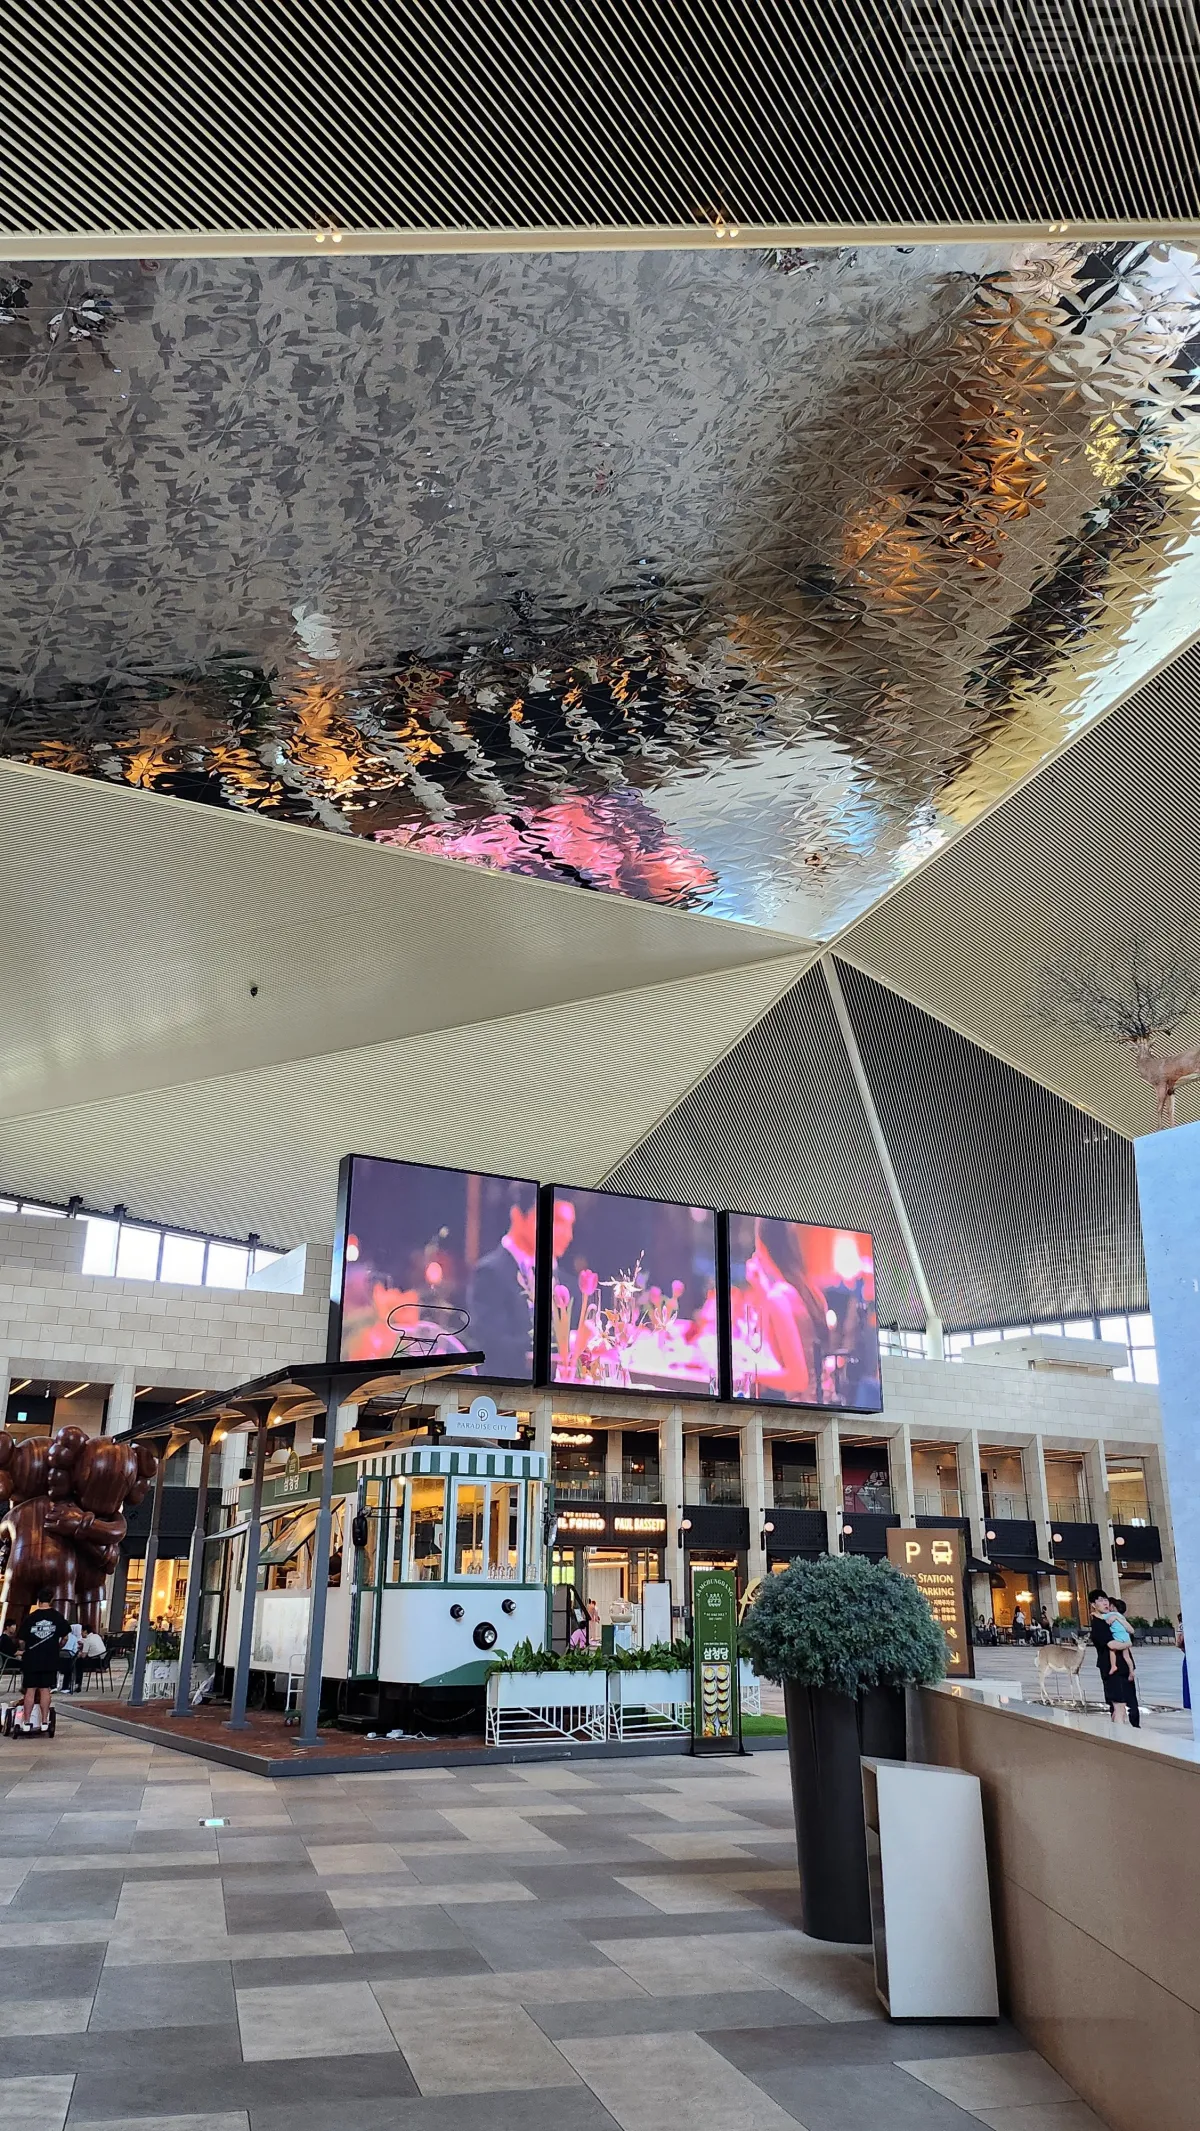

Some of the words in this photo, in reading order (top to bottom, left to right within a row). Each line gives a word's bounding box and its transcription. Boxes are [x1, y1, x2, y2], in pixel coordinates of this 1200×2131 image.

[457, 1422, 491, 1430] PARADISE
[569, 1517, 606, 1531] FORNO
[614, 1517, 633, 1531] PAUL
[634, 1518, 666, 1531] BASSETT
[905, 1541, 921, 1564] P
[917, 1572, 954, 1583] STATION
[696, 1578, 734, 1597] SAMCHUNGDANG
[916, 1586, 955, 1597] PARKING
[703, 1647, 729, 1660] 삼청당
